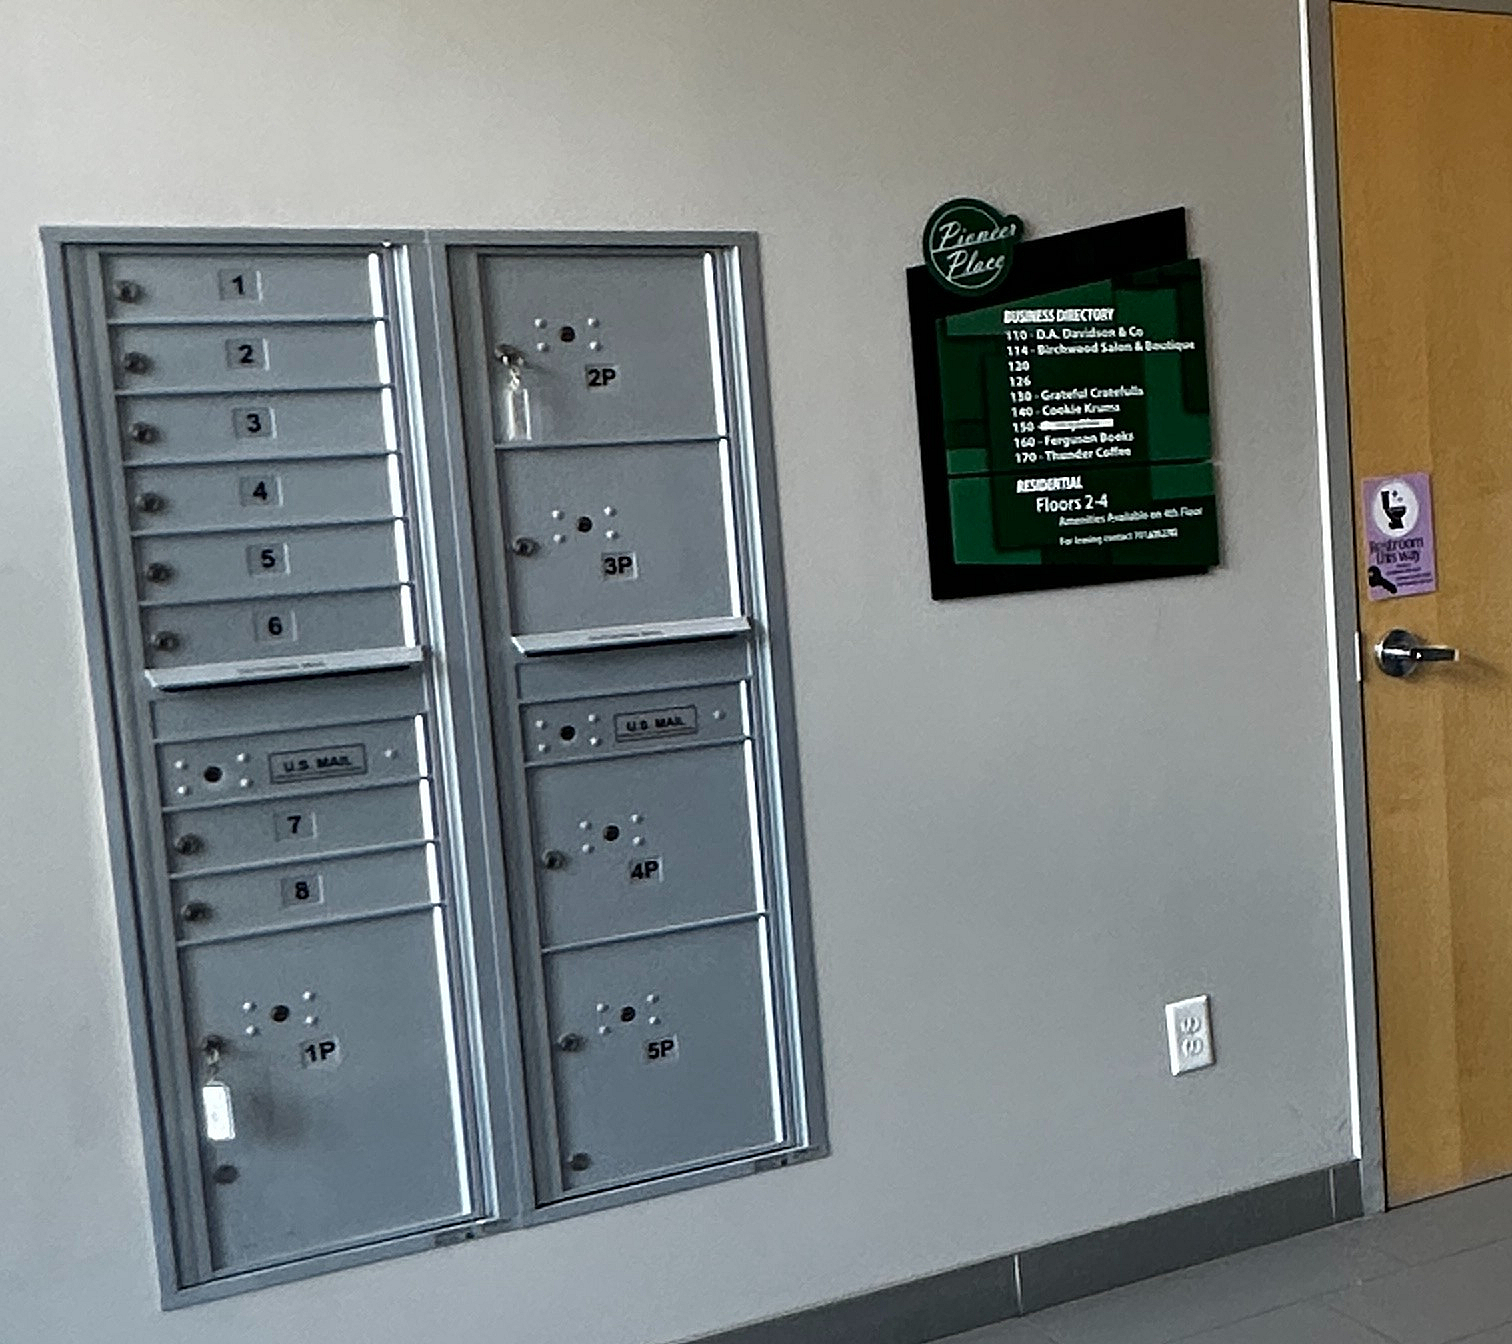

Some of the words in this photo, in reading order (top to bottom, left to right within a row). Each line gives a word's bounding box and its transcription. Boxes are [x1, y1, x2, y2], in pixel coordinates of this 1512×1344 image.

[939, 221, 1017, 251] Pioneer
[946, 249, 1005, 279] Place
[231, 274, 245, 295] 1
[1003, 309, 1055, 323] BUSINESS
[1057, 308, 1115, 322] DIRECTORY
[1005, 330, 1027, 341] 110
[1036, 328, 1060, 339] D.A.
[1062, 327, 1116, 339] Davidson
[1118, 327, 1127, 338] &
[1128, 326, 1144, 337] Co
[238, 344, 254, 364] 2
[1006, 345, 1029, 356] 114
[1037, 342, 1099, 355] Birchwood
[1100, 341, 1133, 353] Salon
[1134, 341, 1143, 352] &
[1145, 339, 1195, 352] Boutique
[1008, 360, 1030, 371] 120
[586, 368, 616, 388] 2P
[1009, 375, 1031, 387] 126
[1041, 388, 1087, 401] Grateful
[1011, 406, 1033, 417] 140
[1042, 404, 1081, 416] Cookie
[246, 413, 262, 434] 3
[1012, 421, 1035, 433] 150
[1013, 437, 1036, 448] 160
[1044, 435, 1097, 447] Ferguson
[1099, 431, 1134, 443] Books
[1015, 452, 1037, 463] 170
[1045, 449, 1093, 461] Thunder
[1095, 446, 1132, 458] Coffee
[252, 480, 268, 501] 4
[1016, 475, 1083, 493] RESIDENTIAL
[1036, 497, 1082, 513] Floors
[1084, 493, 1108, 510] 2-4
[260, 548, 276, 569] 5
[603, 556, 633, 576] 3P
[267, 616, 283, 636] 6
[316, 755, 352, 767] MAIL
[286, 815, 302, 834] 7
[630, 860, 659, 880] 4P
[294, 881, 310, 900] 8
[304, 1040, 336, 1062] 1P
[646, 1039, 675, 1060] 5P
